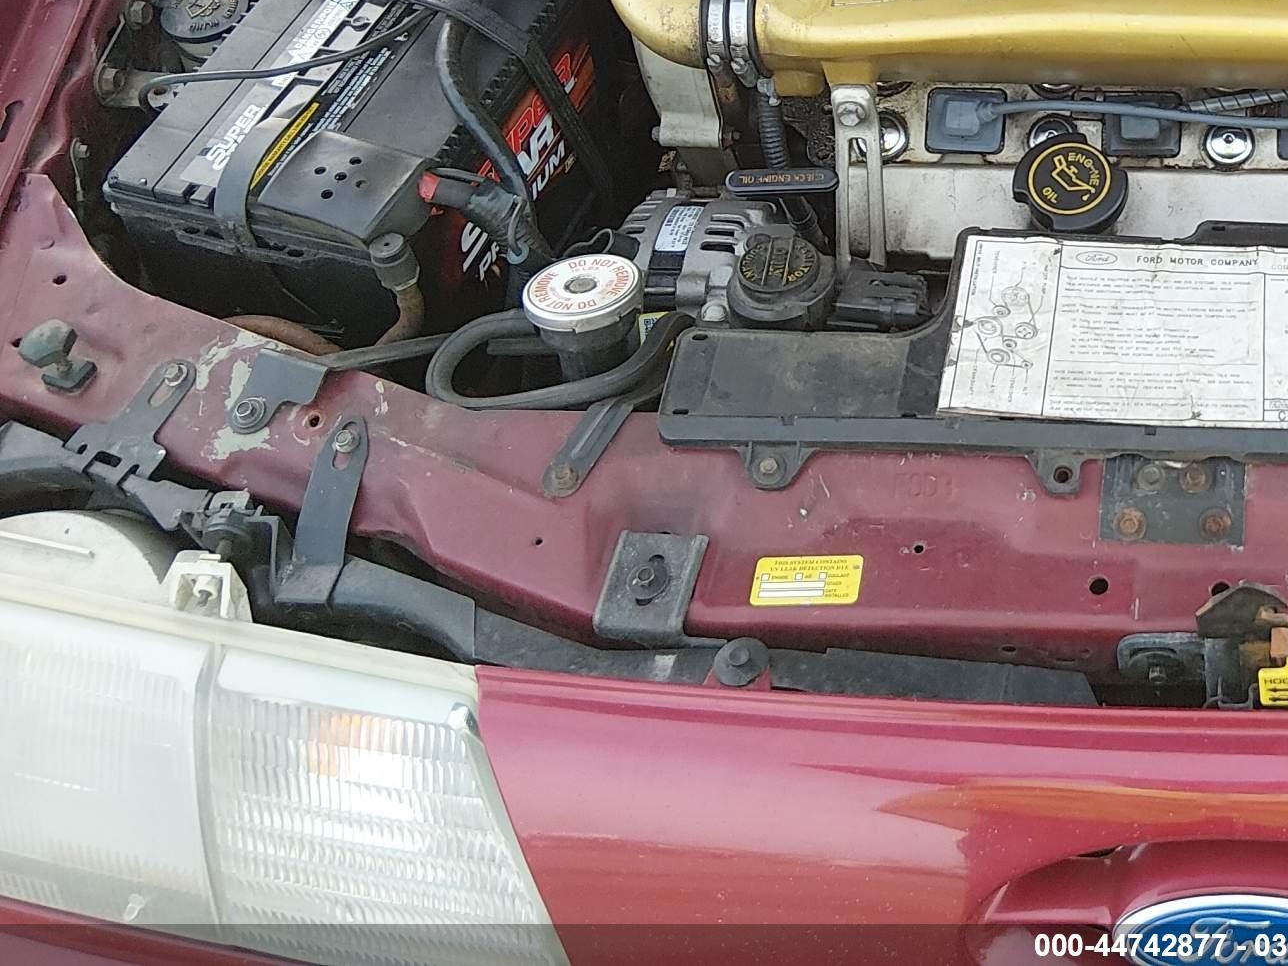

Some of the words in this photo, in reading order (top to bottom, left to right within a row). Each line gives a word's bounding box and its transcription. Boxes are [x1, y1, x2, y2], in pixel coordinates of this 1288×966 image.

[206, 103, 263, 163] SUPER
[739, 175, 754, 184] OIL
[1042, 186, 1058, 204] OIL
[1136, 255, 1163, 264] FORD
[1170, 257, 1203, 265] MOTOR
[1210, 258, 1259, 266] COMPANY
[568, 259, 586, 269] DO
[591, 258, 617, 267] NOT
[607, 265, 629, 297] REMOVE
[535, 271, 558, 303] REMOVE
[544, 300, 573, 310] NOT
[577, 299, 597, 310] DO
